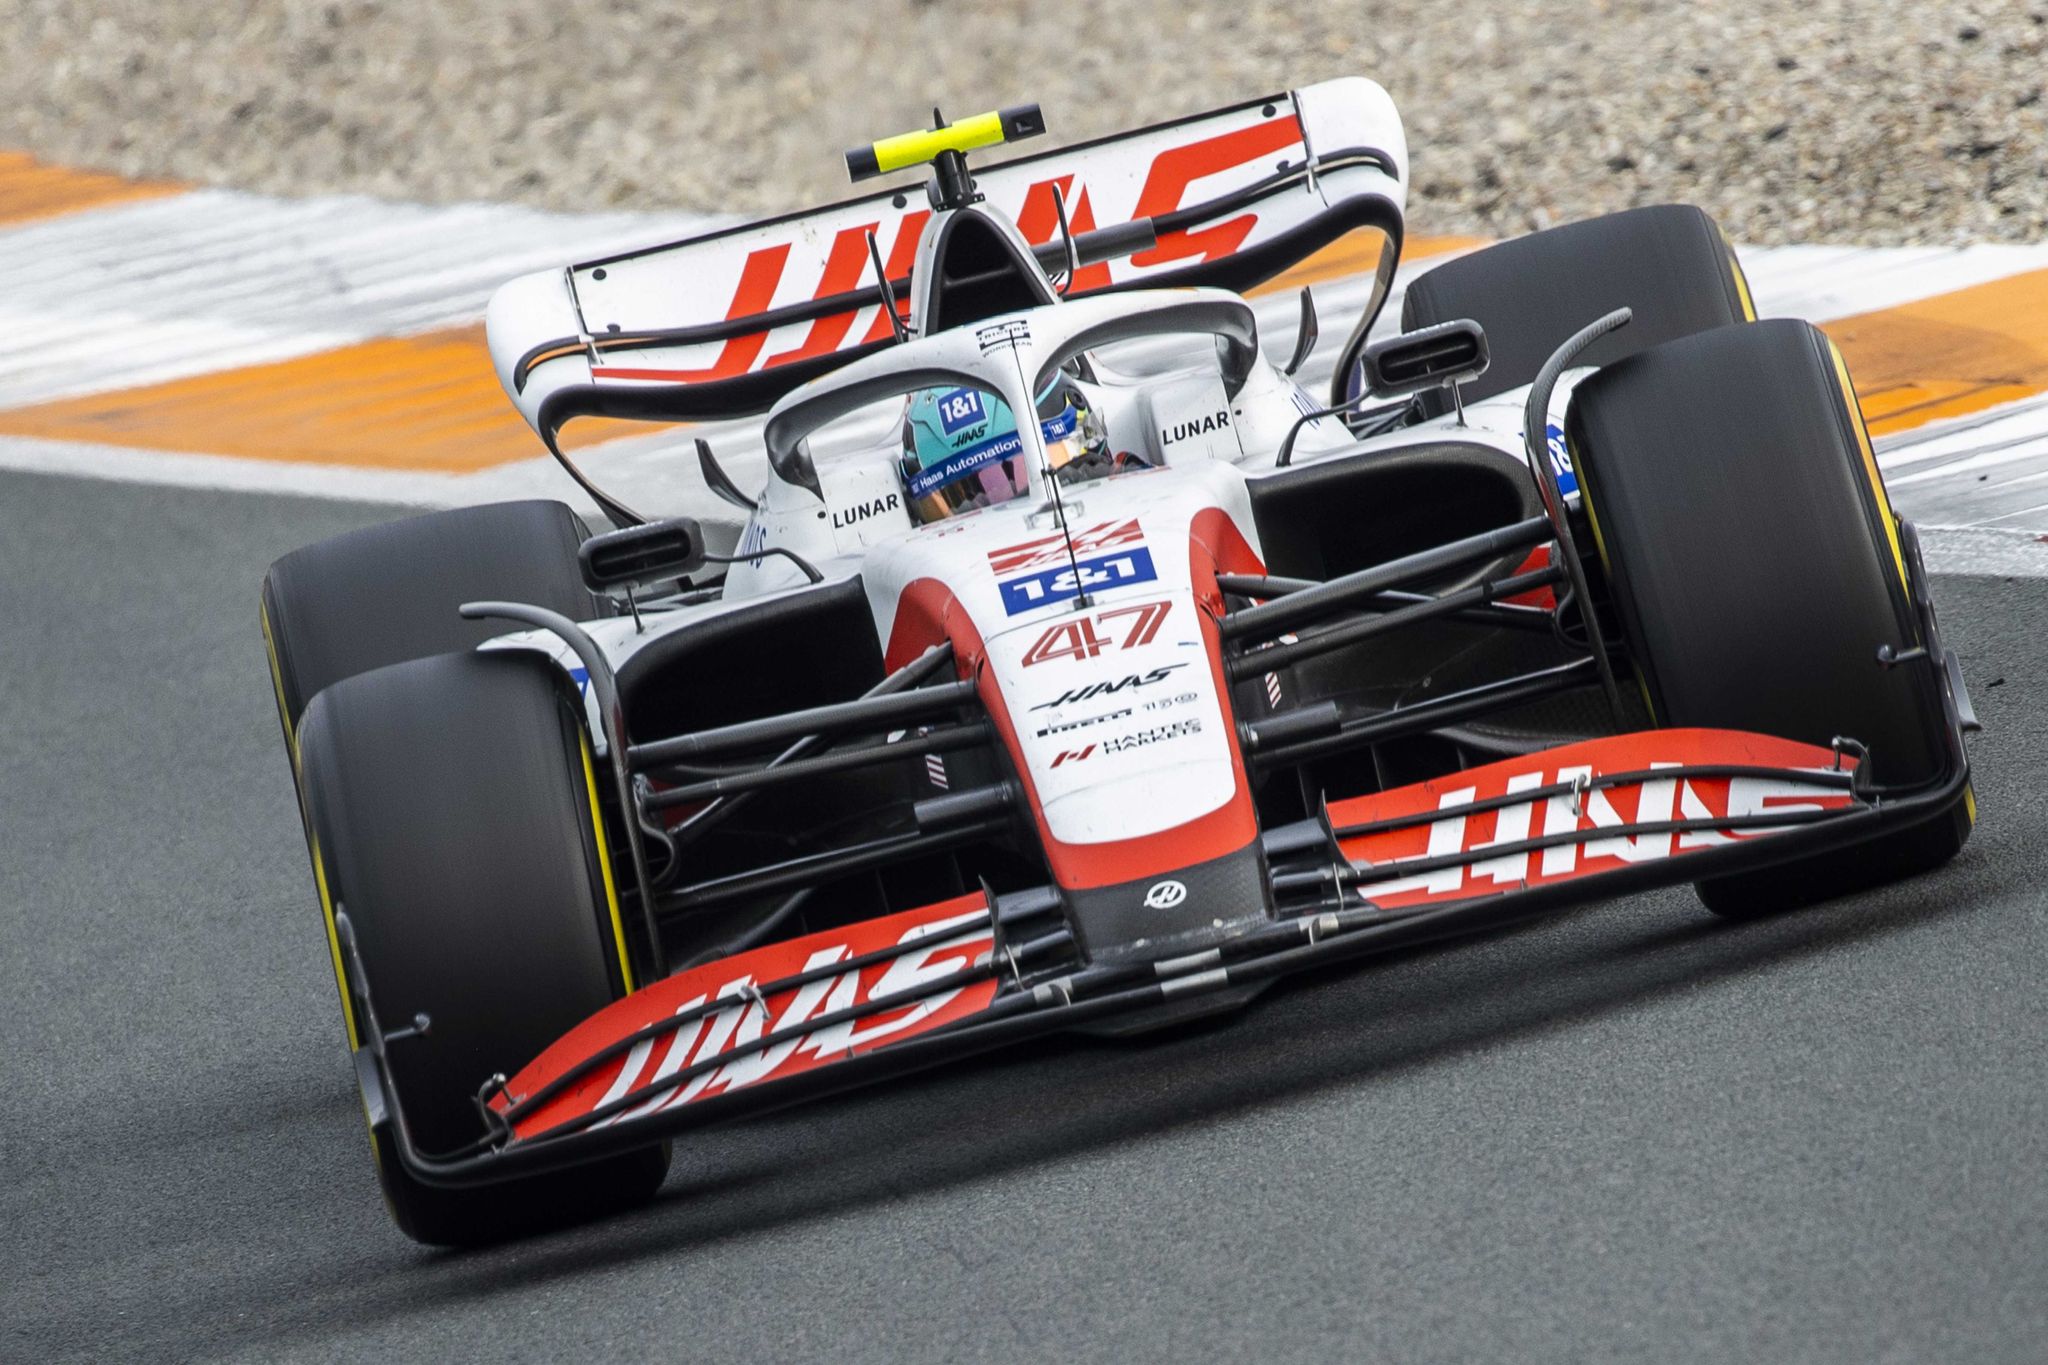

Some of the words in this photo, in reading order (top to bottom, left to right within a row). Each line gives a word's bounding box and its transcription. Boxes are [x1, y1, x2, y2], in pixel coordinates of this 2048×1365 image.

[941, 391, 979, 423] 1&1
[1162, 411, 1229, 446] LUNAR
[951, 424, 988, 448] HAAS
[920, 471, 944, 488] Haas
[946, 438, 1021, 476] Automation
[832, 493, 899, 529] LUNAR
[1013, 556, 1136, 601] 1&1
[1022, 600, 1173, 668] 47
[1028, 662, 1191, 713] HAAS
[1357, 762, 1852, 897] HAAS
[586, 908, 994, 1132] HAAS
